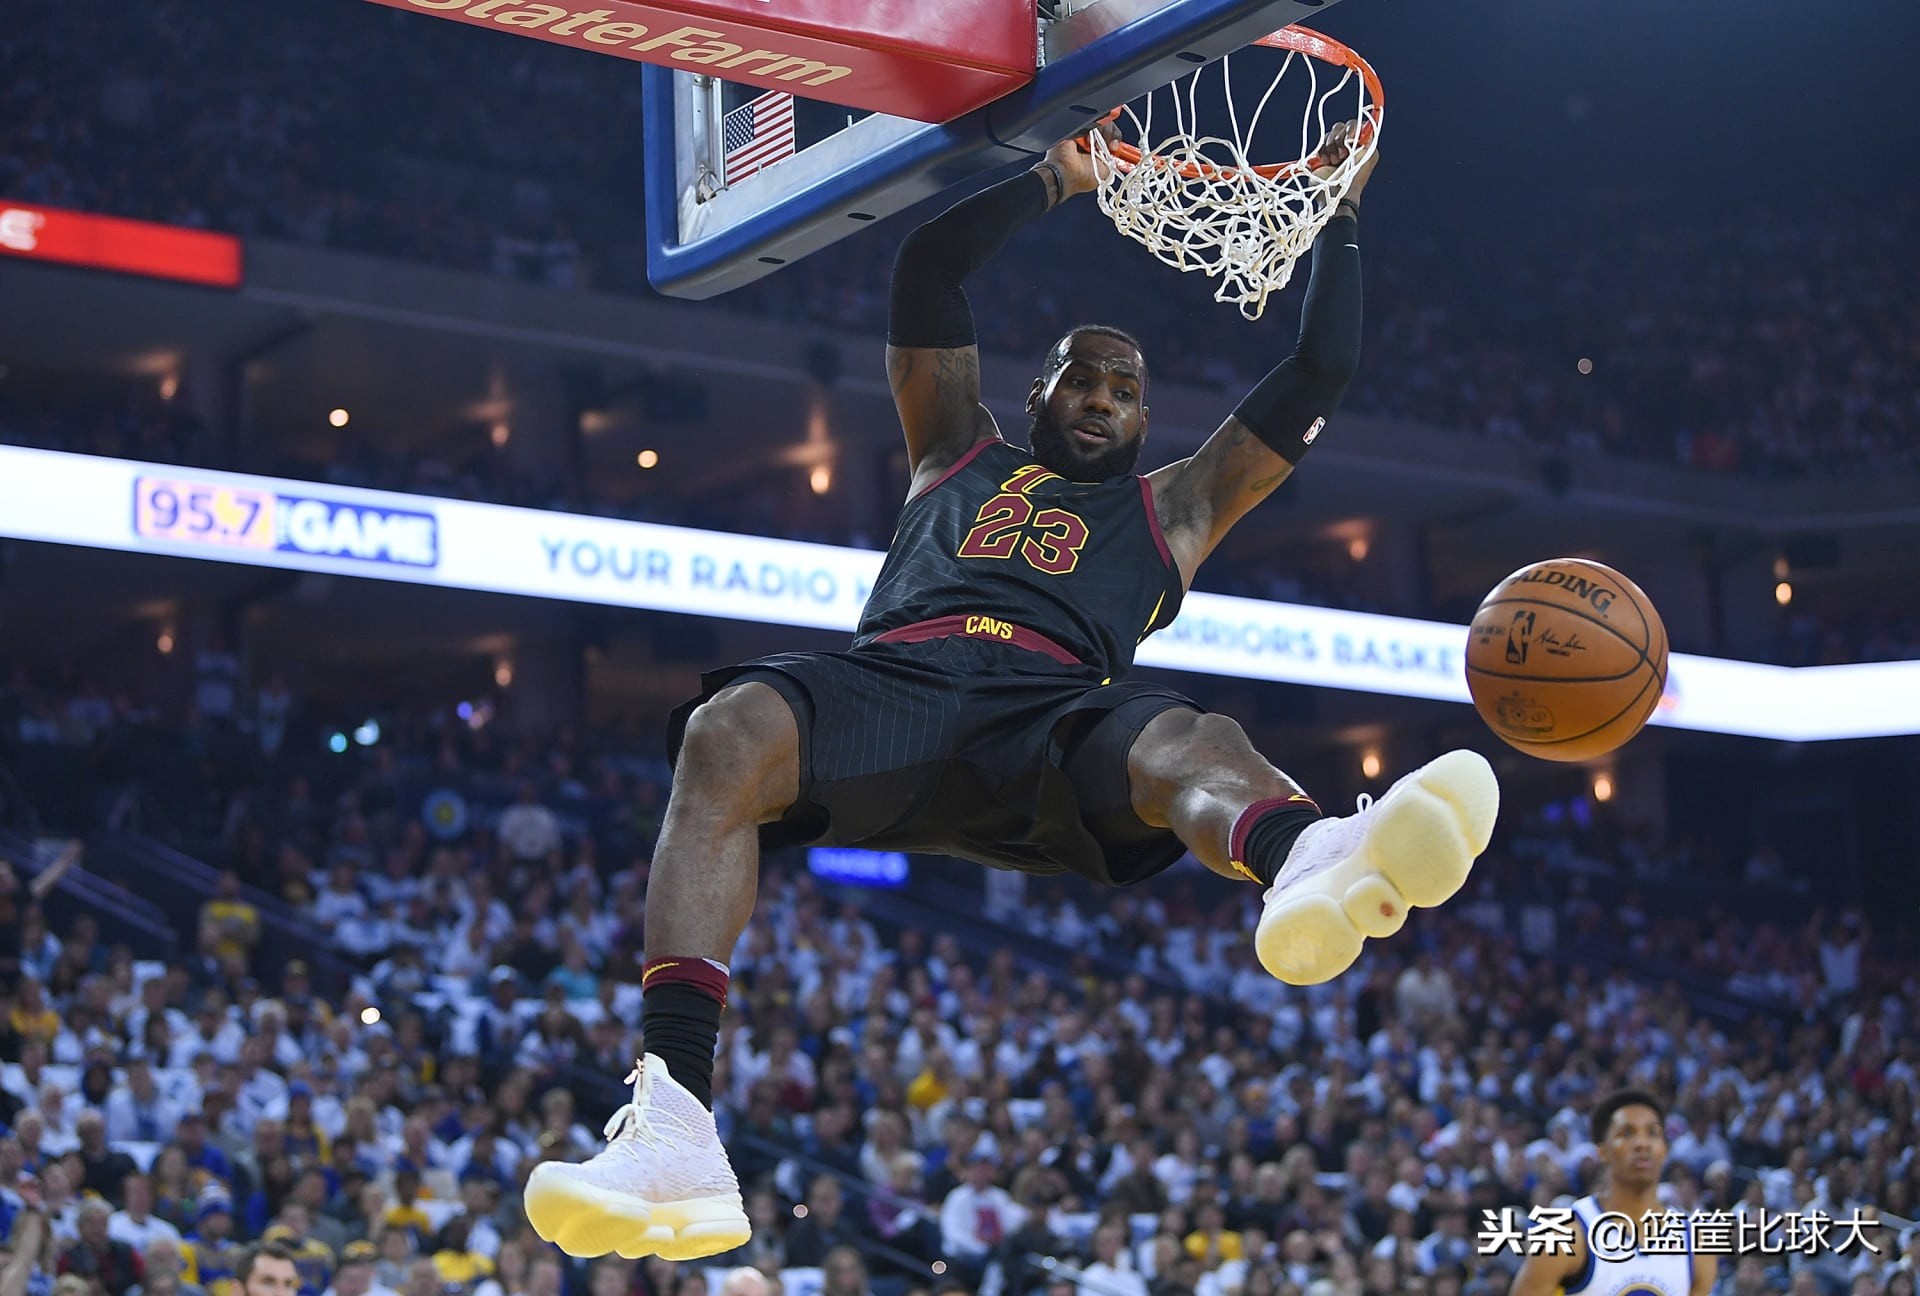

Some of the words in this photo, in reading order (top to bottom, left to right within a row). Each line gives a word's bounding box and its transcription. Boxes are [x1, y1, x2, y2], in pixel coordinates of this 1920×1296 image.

[150, 487, 261, 538] 95.7
[290, 500, 433, 563] GAME
[956, 493, 1090, 575] 23
[539, 536, 673, 585] YOUR
[691, 554, 838, 604] RADIO
[1510, 569, 1617, 613] ALDING
[965, 615, 1014, 640] CAVS
[1332, 631, 1461, 680] BASKE
